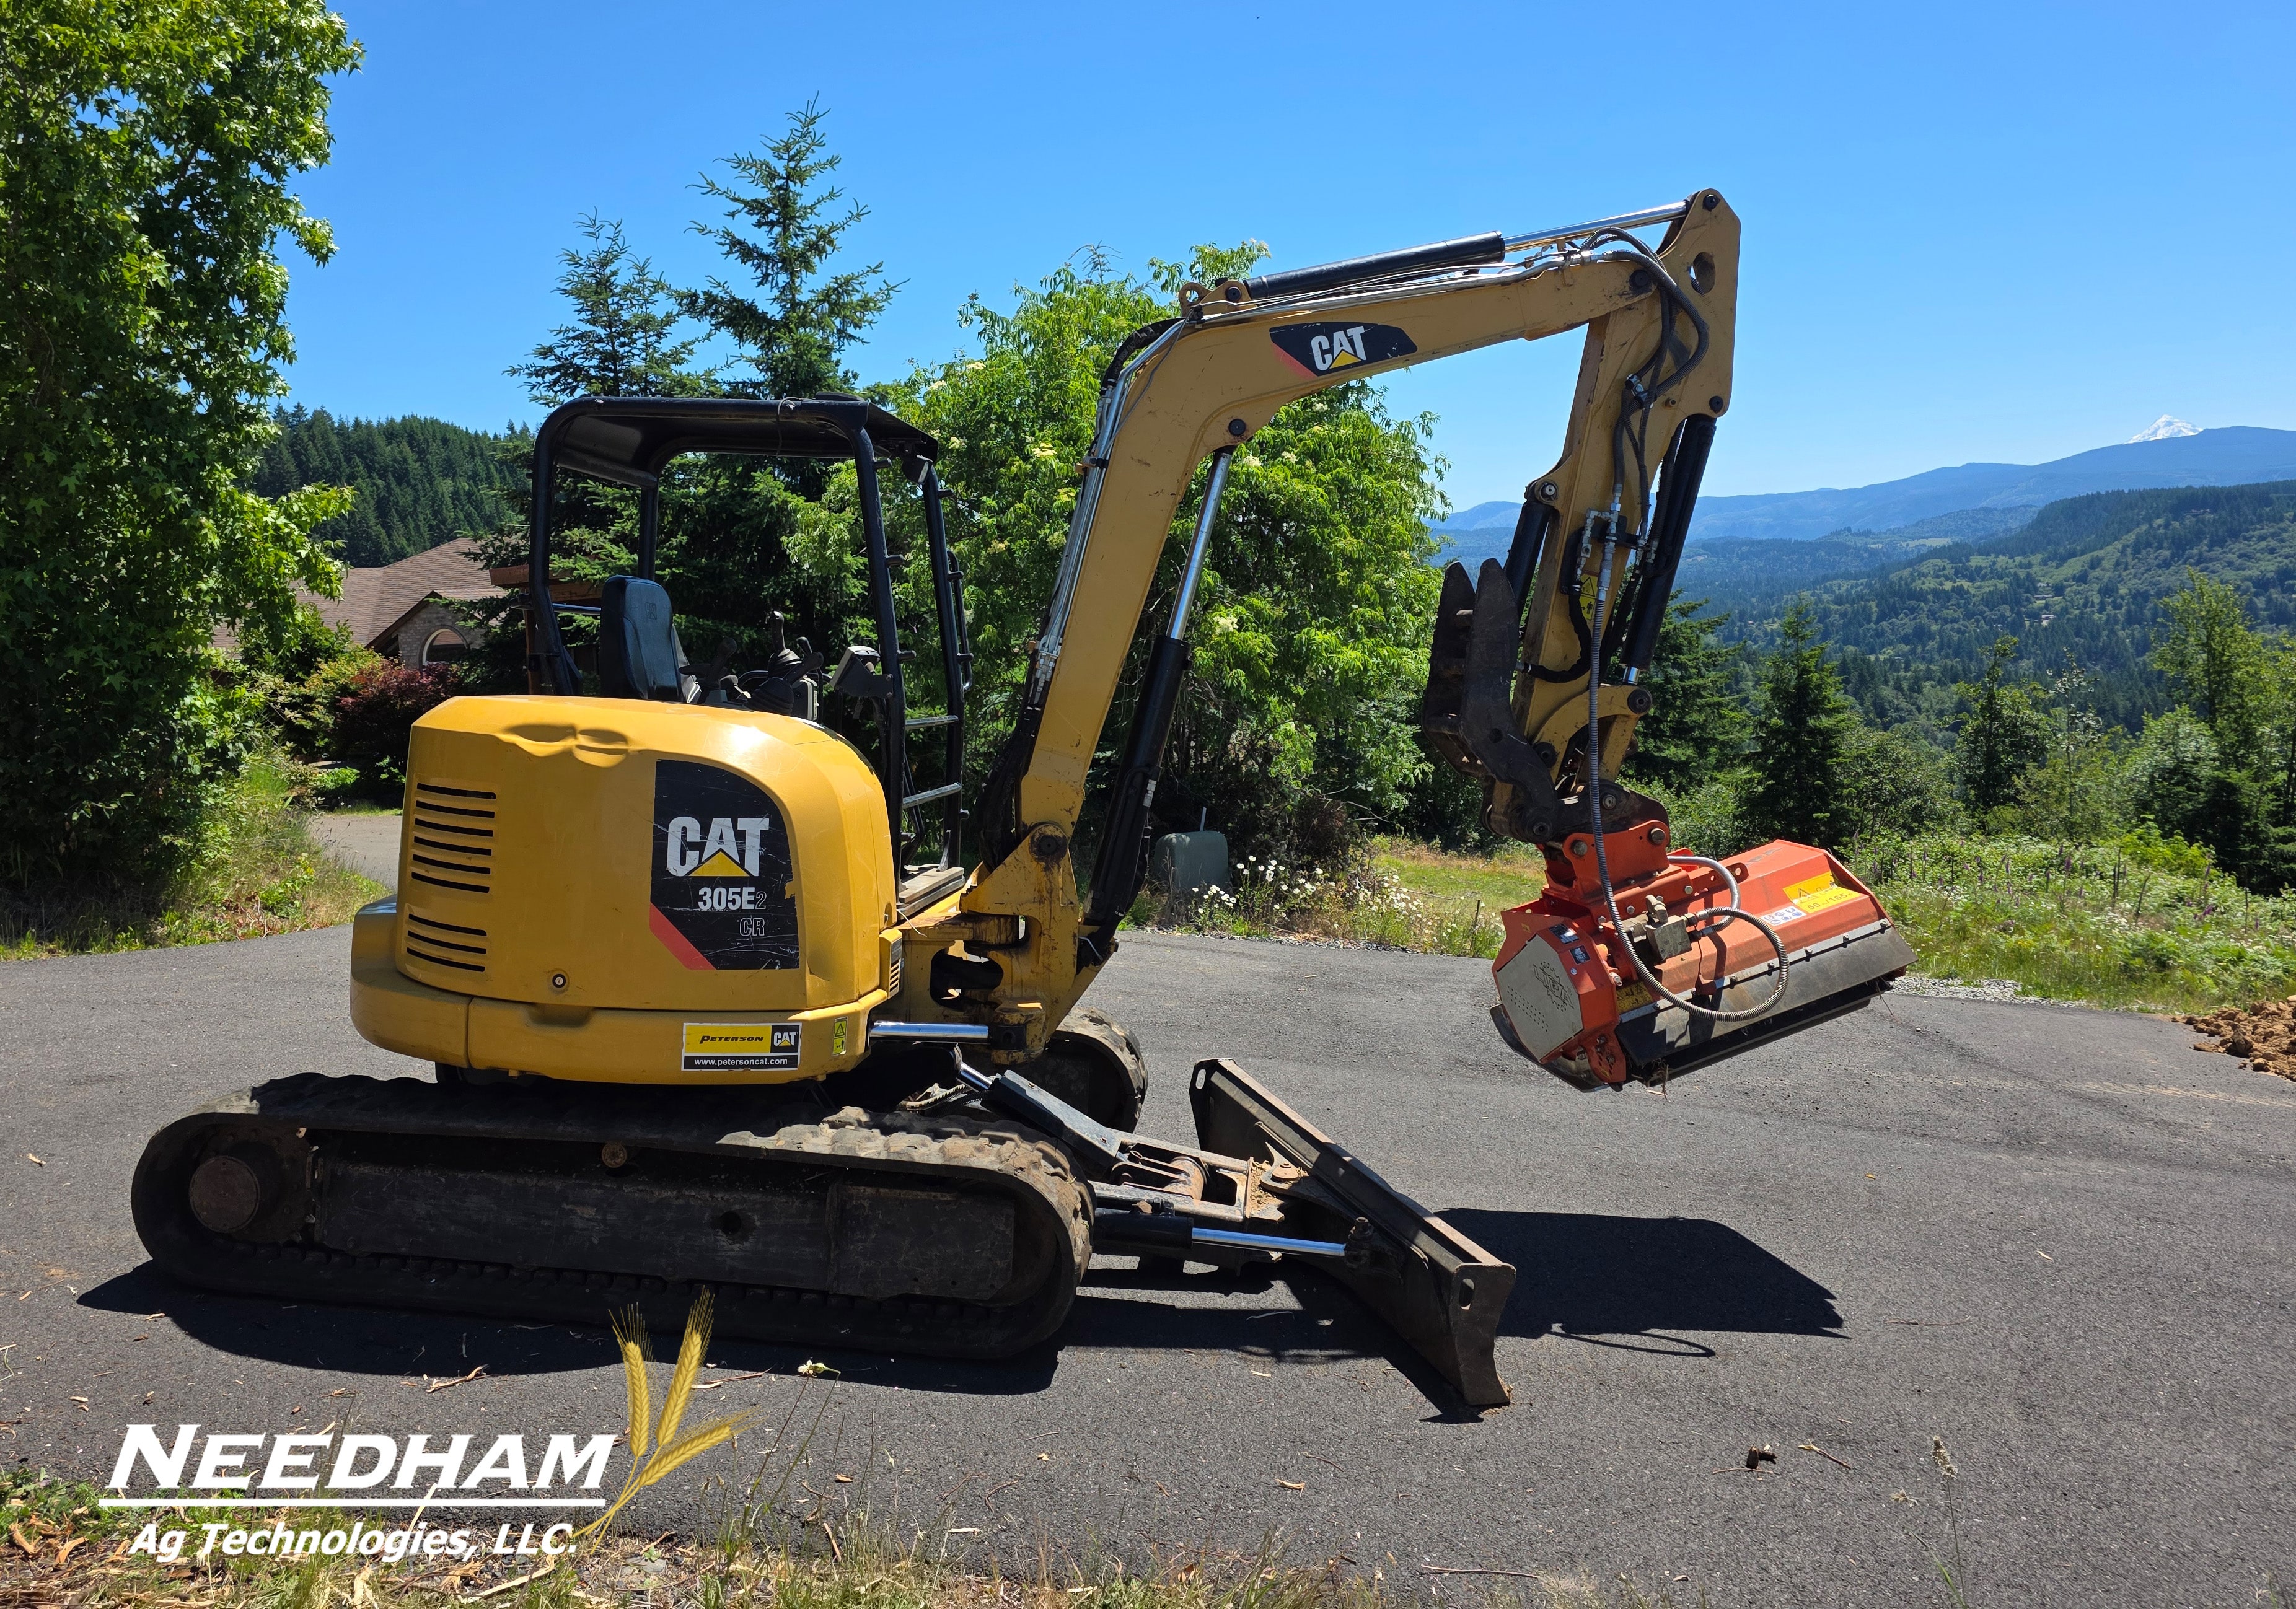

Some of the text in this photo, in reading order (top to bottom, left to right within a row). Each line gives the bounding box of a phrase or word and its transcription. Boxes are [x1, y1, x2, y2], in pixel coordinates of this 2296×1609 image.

[1311, 325, 1366, 370] CAT
[667, 816, 769, 877] CAT
[698, 887, 767, 910] 305E2
[739, 918, 765, 936] CR
[699, 1032, 797, 1046] PETERSON CAT
[694, 1058, 788, 1066] www.petersoncat.com
